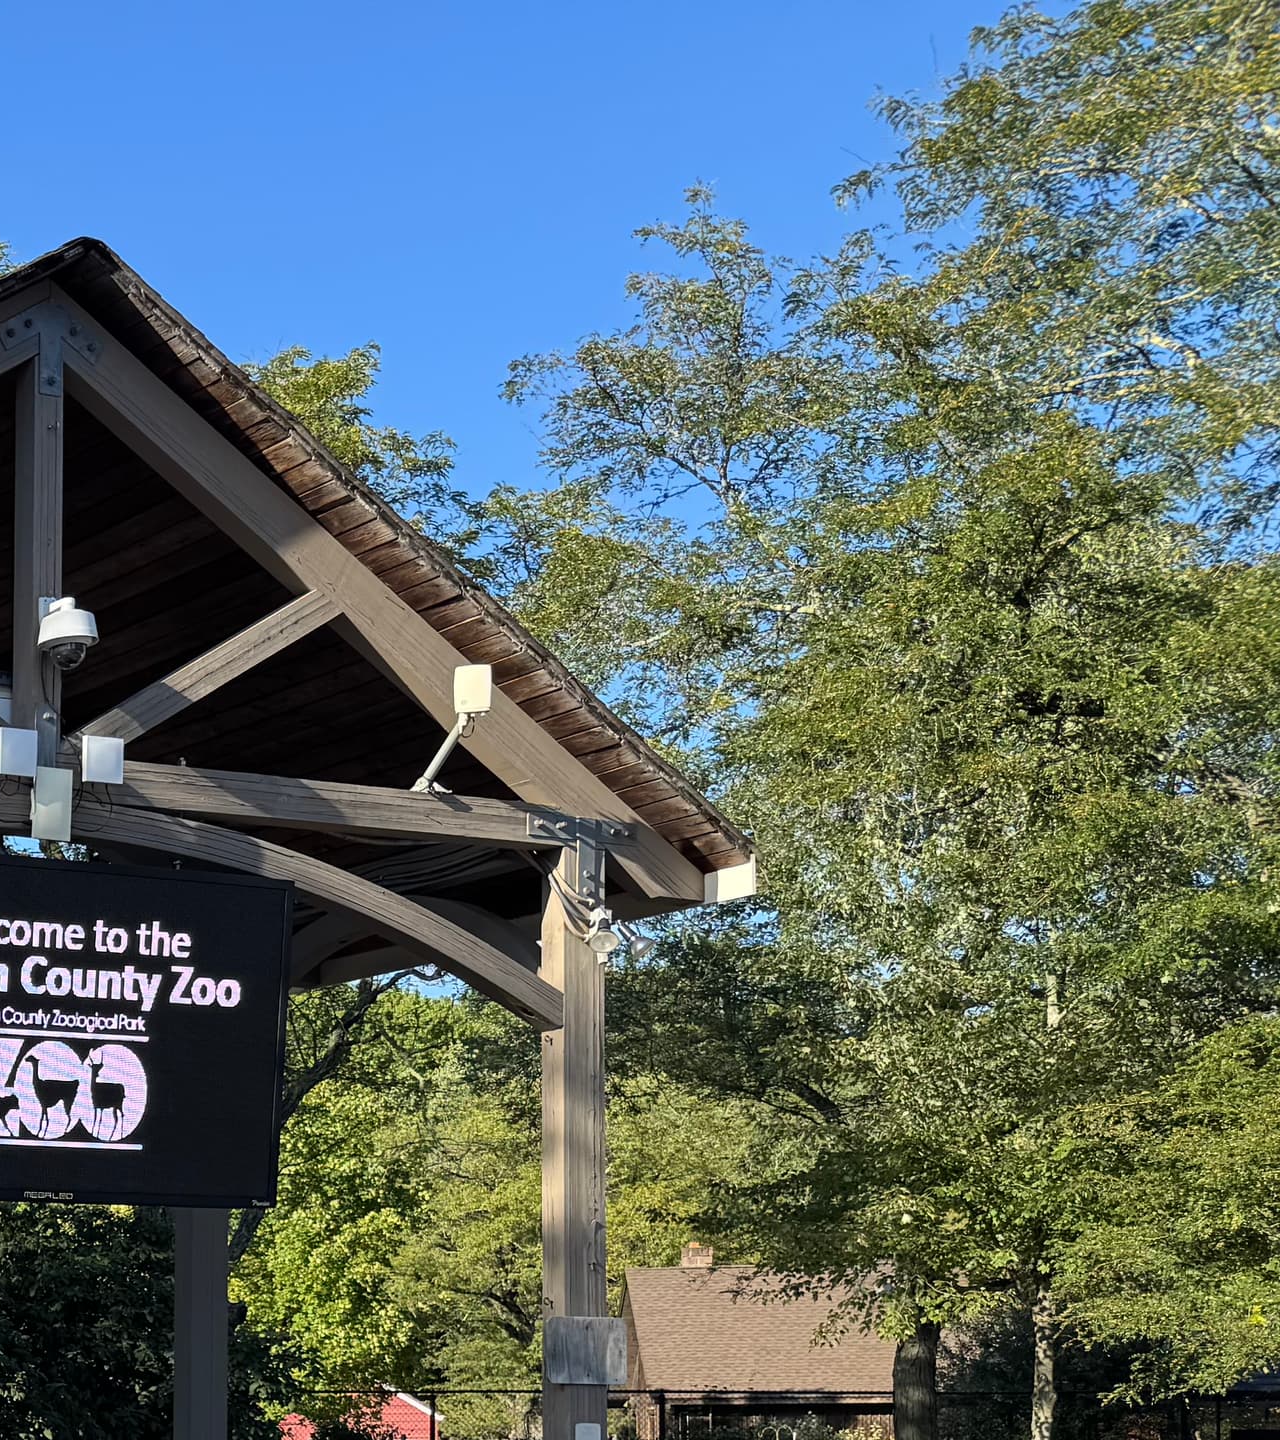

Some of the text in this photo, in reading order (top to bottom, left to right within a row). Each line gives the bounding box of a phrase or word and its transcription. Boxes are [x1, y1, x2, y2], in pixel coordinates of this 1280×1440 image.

[92, 919, 129, 954] to
[135, 920, 192, 959] the
[20, 955, 163, 1012] County
[168, 965, 242, 1008] Zoo
[2, 1006, 52, 1029] County
[51, 1009, 119, 1033] Zoological
[119, 1013, 146, 1032] Park
